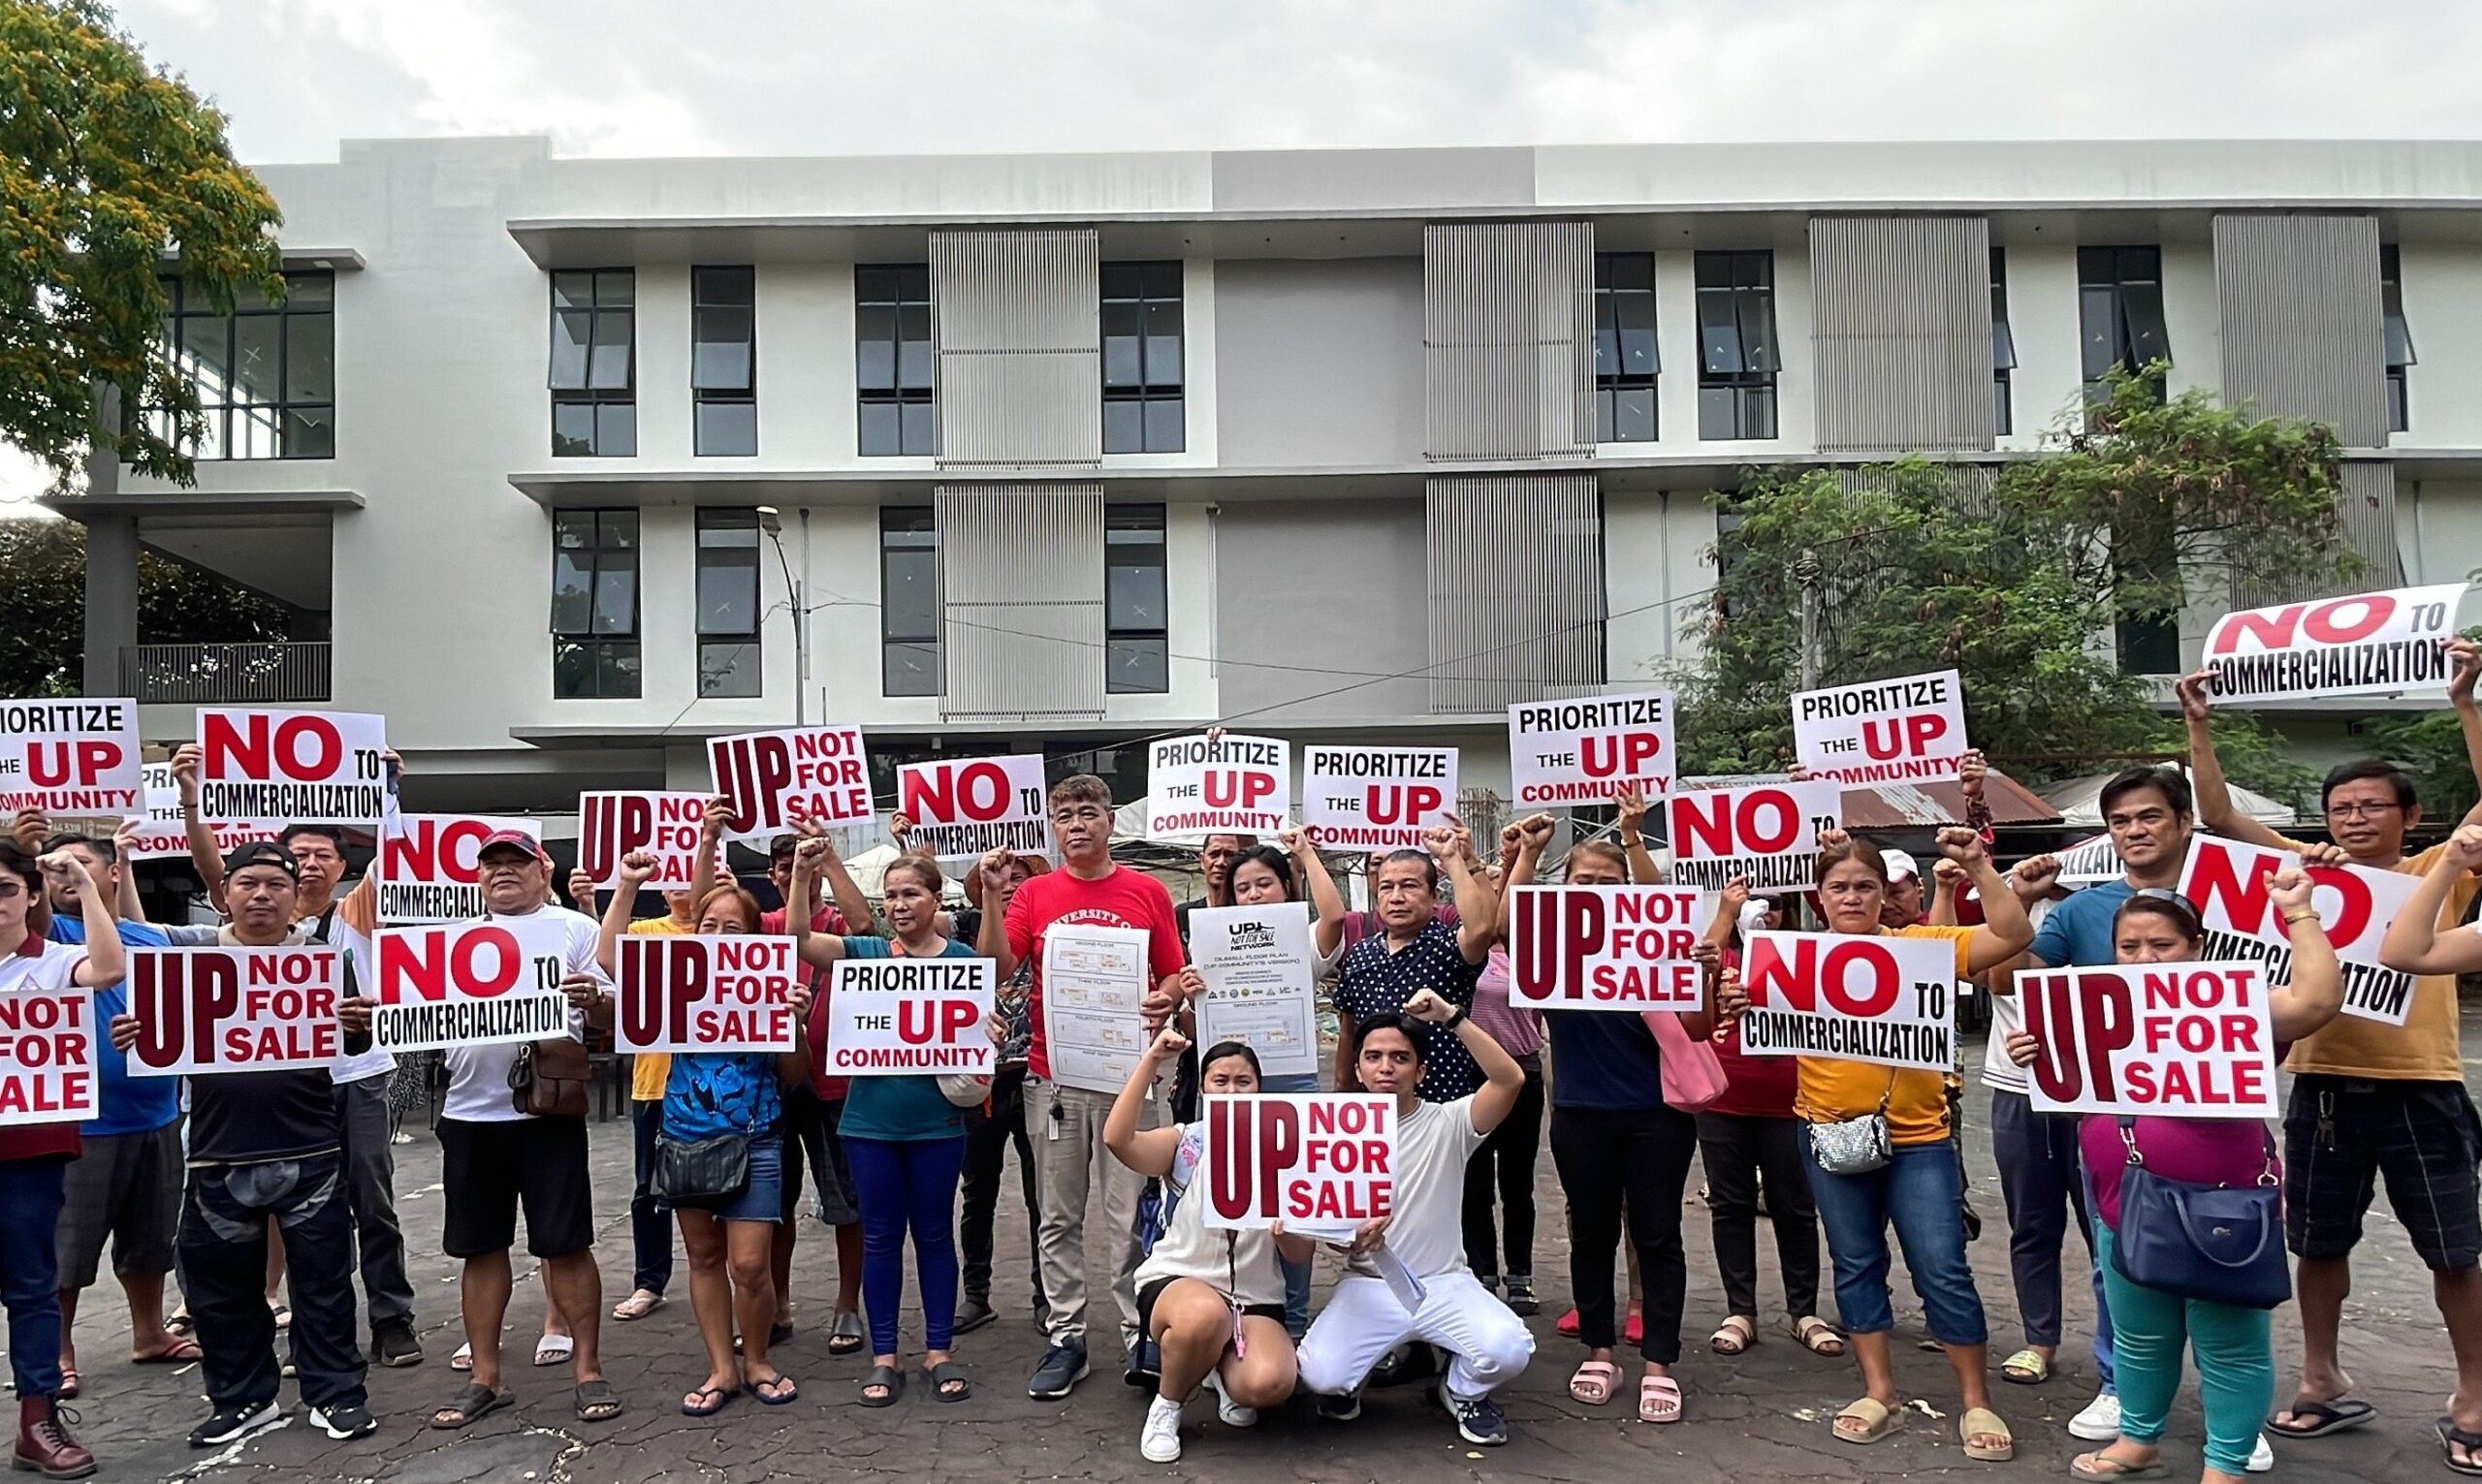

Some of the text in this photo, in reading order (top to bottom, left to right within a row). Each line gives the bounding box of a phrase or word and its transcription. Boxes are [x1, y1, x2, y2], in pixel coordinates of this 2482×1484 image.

[2212, 595, 2446, 654] NO TO
[2209, 638, 2445, 696] COMMERCIALIZATION
[1520, 698, 1662, 733] PRIORITIZE
[1802, 679, 1947, 721] PRIORITIZE
[0, 706, 123, 733] IORITIZE
[1821, 713, 1947, 760] THE UP
[205, 714, 342, 781] NO
[355, 750, 380, 779] TO
[795, 731, 857, 759] NOT
[1157, 741, 1279, 768] PRIORITIZE
[1537, 733, 1660, 777] THE UP
[0, 759, 20, 774] HE
[27, 742, 122, 787] UP
[797, 760, 863, 789] FOR
[1315, 752, 1447, 777] PRIORITIZE
[0, 790, 137, 811] OMMUNITY
[203, 783, 383, 818] COMMERCIALIZATION
[713, 735, 791, 834] UP
[904, 762, 1040, 825] NO TO
[1167, 771, 1276, 808] THE UP
[149, 808, 186, 820] THE
[660, 798, 711, 822] NO
[786, 789, 870, 822] SALE
[1154, 811, 1284, 832] COMMUNITY
[1325, 785, 1442, 825] THE UP
[1672, 789, 1799, 858] NO
[138, 832, 282, 851] COMUNITY
[384, 820, 494, 883] NO
[583, 796, 652, 883] UP
[657, 827, 719, 850] FO
[1309, 826, 1419, 846] COMMUNI
[1675, 853, 1816, 891] COMMERCIALIZATI
[381, 884, 483, 918] COMMERCIALI
[1615, 894, 1696, 924] NOT
[2186, 842, 2372, 951] NO
[1229, 923, 1256, 934] UP
[1230, 942, 1275, 951] NETWORK
[1231, 934, 1246, 944] NOT
[1258, 931, 1275, 941] SALE
[1516, 891, 1605, 1000] UP
[1613, 929, 1695, 960] FOR
[249, 954, 335, 985] NOT
[379, 927, 559, 1004] NO TO
[717, 942, 790, 970] NOT
[620, 939, 708, 1046] UP
[715, 976, 788, 1004] FOR
[842, 965, 983, 992] PRIORITIZE
[1592, 965, 1696, 1000] SALE
[1749, 937, 1900, 1018] NO
[1915, 982, 1945, 1020] TO
[2145, 970, 2254, 1009] NOT
[134, 953, 239, 1067] UP
[246, 989, 335, 1021] FOR
[377, 996, 562, 1047] COMMERCIALIZATION
[854, 1000, 979, 1045] THE UP
[225, 1024, 337, 1062] SALE
[696, 1010, 789, 1042] SALE
[1745, 1011, 1949, 1064] COMMERCIALIZATION
[2022, 973, 2133, 1103] UP
[2144, 1014, 2261, 1053] FOR
[836, 1047, 988, 1067] COMMUNITY
[0, 1072, 89, 1114] ALE
[2124, 1060, 2266, 1104] SALE
[1309, 1101, 1388, 1134] NOT
[1209, 1100, 1299, 1219] UP
[1307, 1140, 1388, 1174] FOR
[1288, 1181, 1392, 1218] SALE
